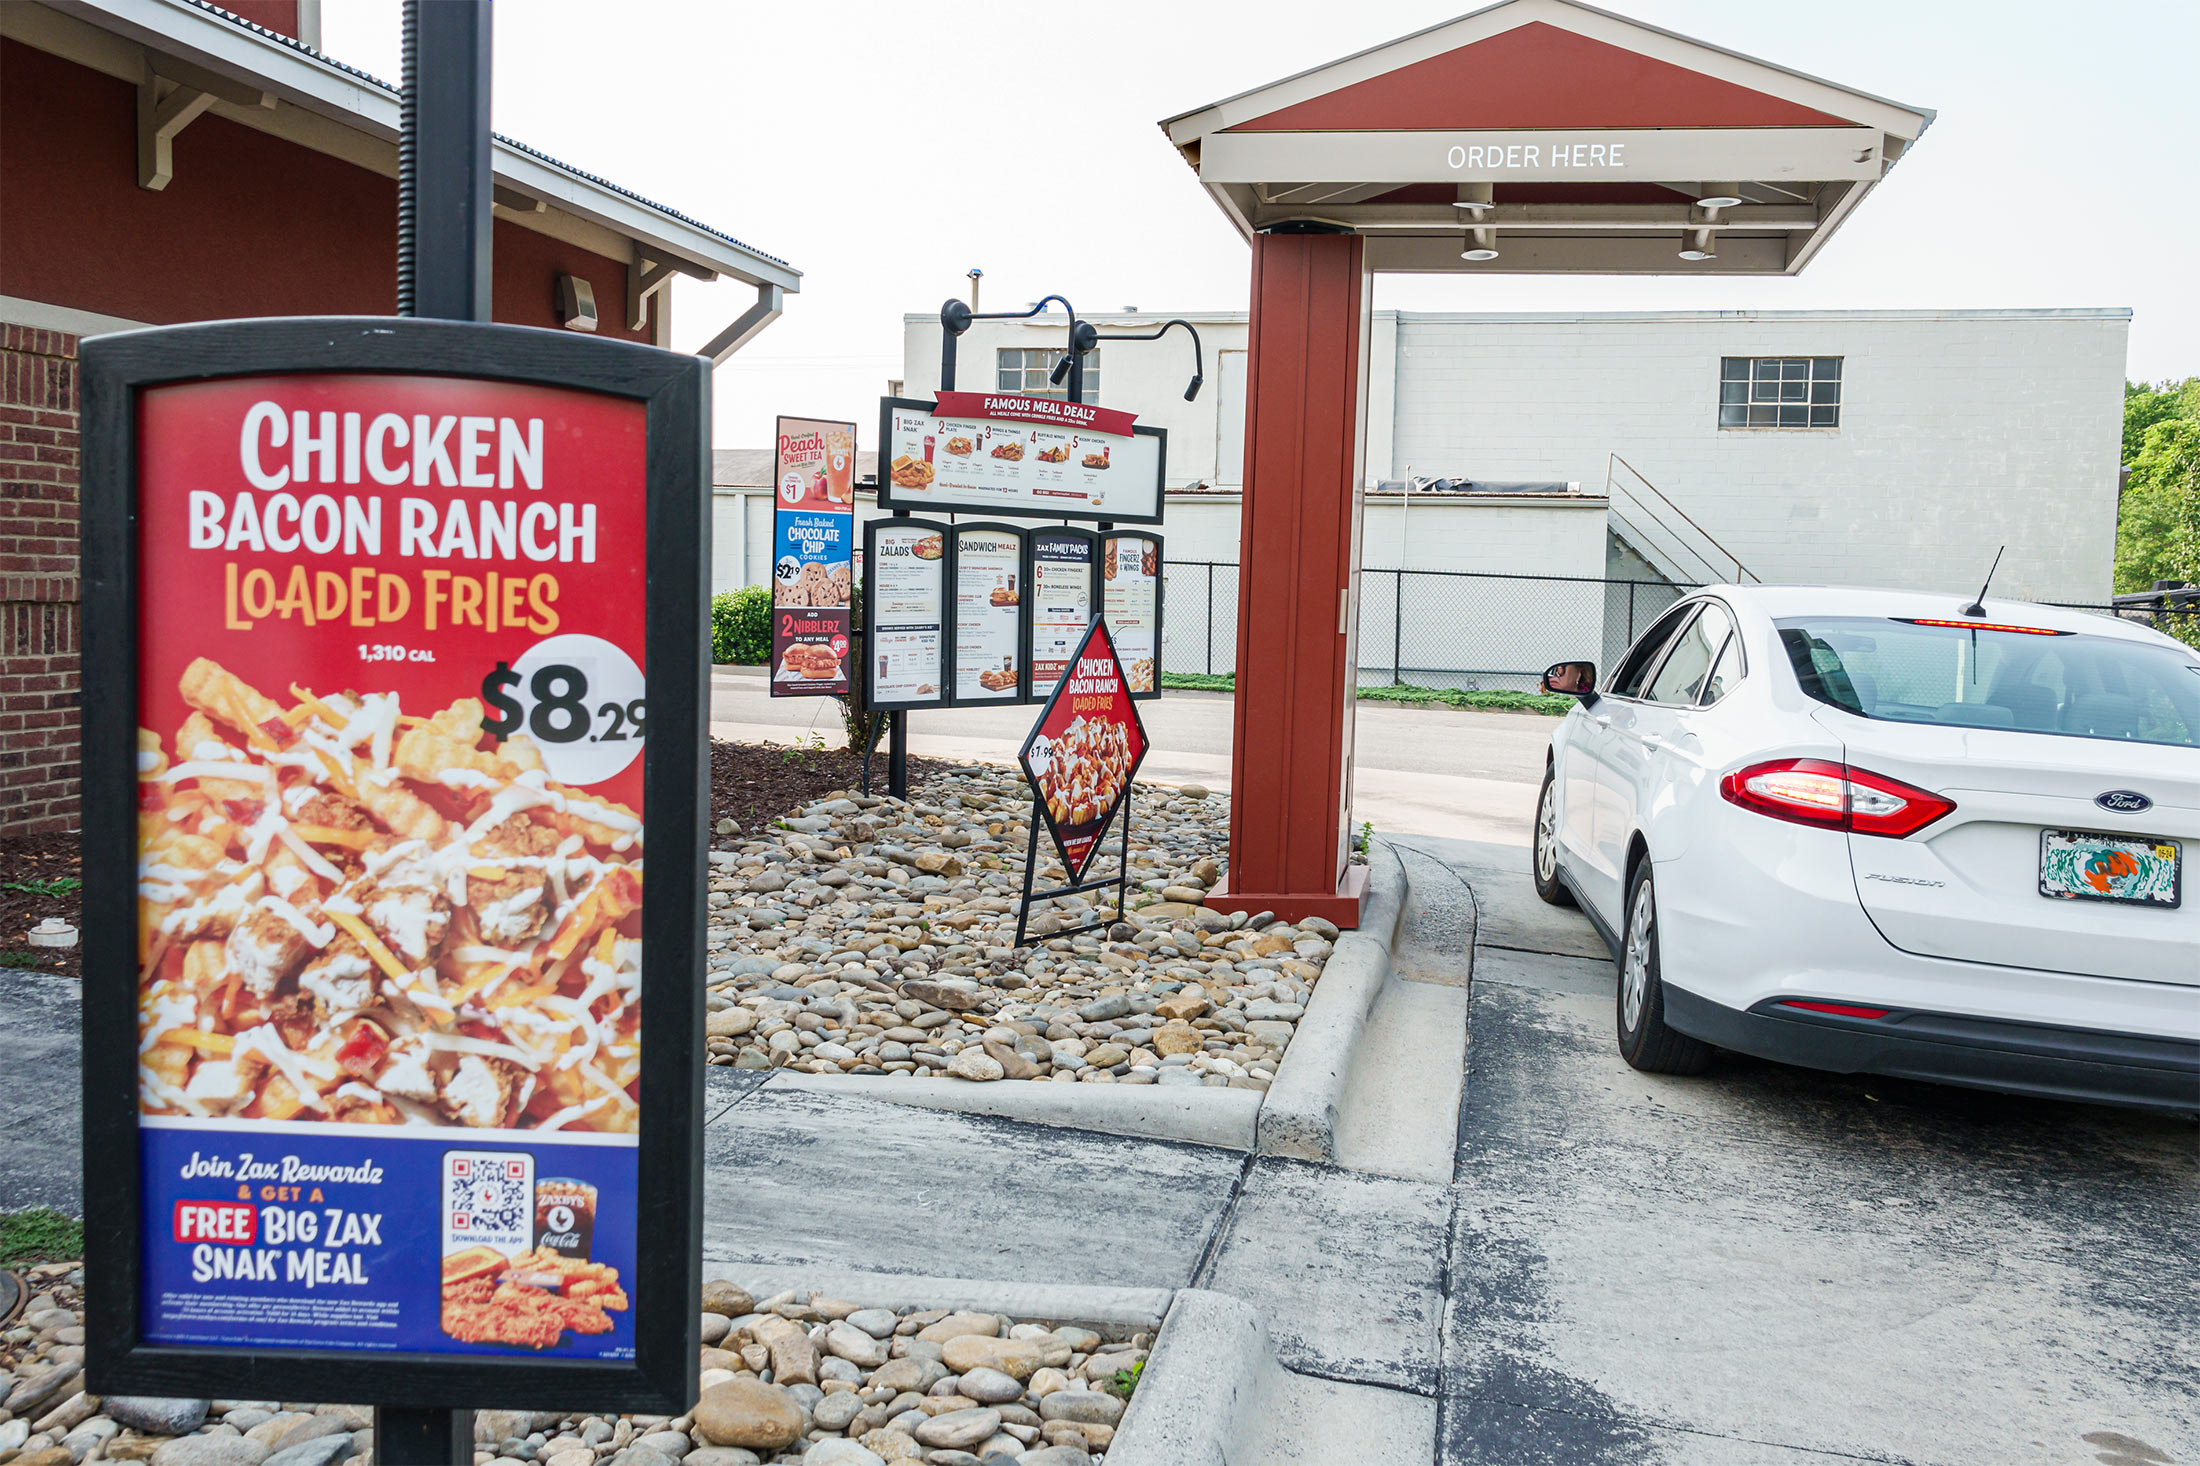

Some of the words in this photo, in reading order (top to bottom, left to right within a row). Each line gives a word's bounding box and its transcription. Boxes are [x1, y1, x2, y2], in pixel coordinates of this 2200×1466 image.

[1447, 145, 1540, 169] ORDER
[1551, 143, 1625, 167] HERE
[984, 398, 1030, 412] FAMOUS
[1033, 400, 1061, 415] MEAL
[1064, 404, 1096, 421] DEALZ
[895, 416, 900, 431] 1
[938, 420, 945, 434] 2
[985, 425, 992, 439] 3
[1030, 431, 1037, 444] 4
[240, 400, 544, 491] CHICKEN
[779, 432, 825, 456] Peach
[1072, 436, 1078, 448] 5
[784, 452, 808, 464] SWEET
[810, 451, 822, 460] TEA
[786, 484, 796, 500] $1
[189, 490, 382, 556] BACON
[399, 496, 597, 563] RANCH
[794, 516, 813, 526] Fresh
[814, 518, 834, 528] Baked
[788, 526, 840, 542] CHOCOLATE
[802, 540, 825, 554] CHIP
[880, 546, 910, 556] ZALADS
[959, 540, 997, 552] SANDWICH
[1036, 544, 1048, 552] ZAX
[1050, 542, 1070, 554] FAMILY
[1120, 554, 1140, 563] FINGERZ
[1036, 566, 1042, 578] 6
[1124, 564, 1140, 572] WINGS
[225, 562, 411, 631] LOADED
[422, 569, 560, 635] FRIES
[1036, 584, 1042, 597] 7
[782, 614, 793, 637] 2
[794, 619, 840, 634] NIBBLERZ
[358, 643, 406, 663] 1,310
[408, 650, 436, 662] CAL
[1035, 663, 1044, 671] ZAX
[1076, 656, 1114, 679] CHICKEN
[1069, 679, 1094, 694] BACON
[1095, 678, 1118, 694] RANCH
[480, 661, 646, 744] $8.29
[1072, 696, 1096, 714] LOADED
[1097, 696, 1113, 711] FRIES
[2107, 793, 2141, 809] Ford
[180, 1151, 234, 1180] Join
[235, 1153, 280, 1182] Zax
[281, 1155, 384, 1184] Rewardz
[237, 1184, 251, 1200] &
[260, 1186, 302, 1202] GET
[309, 1187, 325, 1203] A
[180, 1206, 251, 1240] FREE
[260, 1206, 319, 1245] BIG
[324, 1208, 383, 1247] ZAX
[452, 1234, 492, 1244] DOWNLOAD
[494, 1236, 506, 1244] THE
[509, 1236, 524, 1244] APP
[286, 1248, 369, 1289] MEAL
